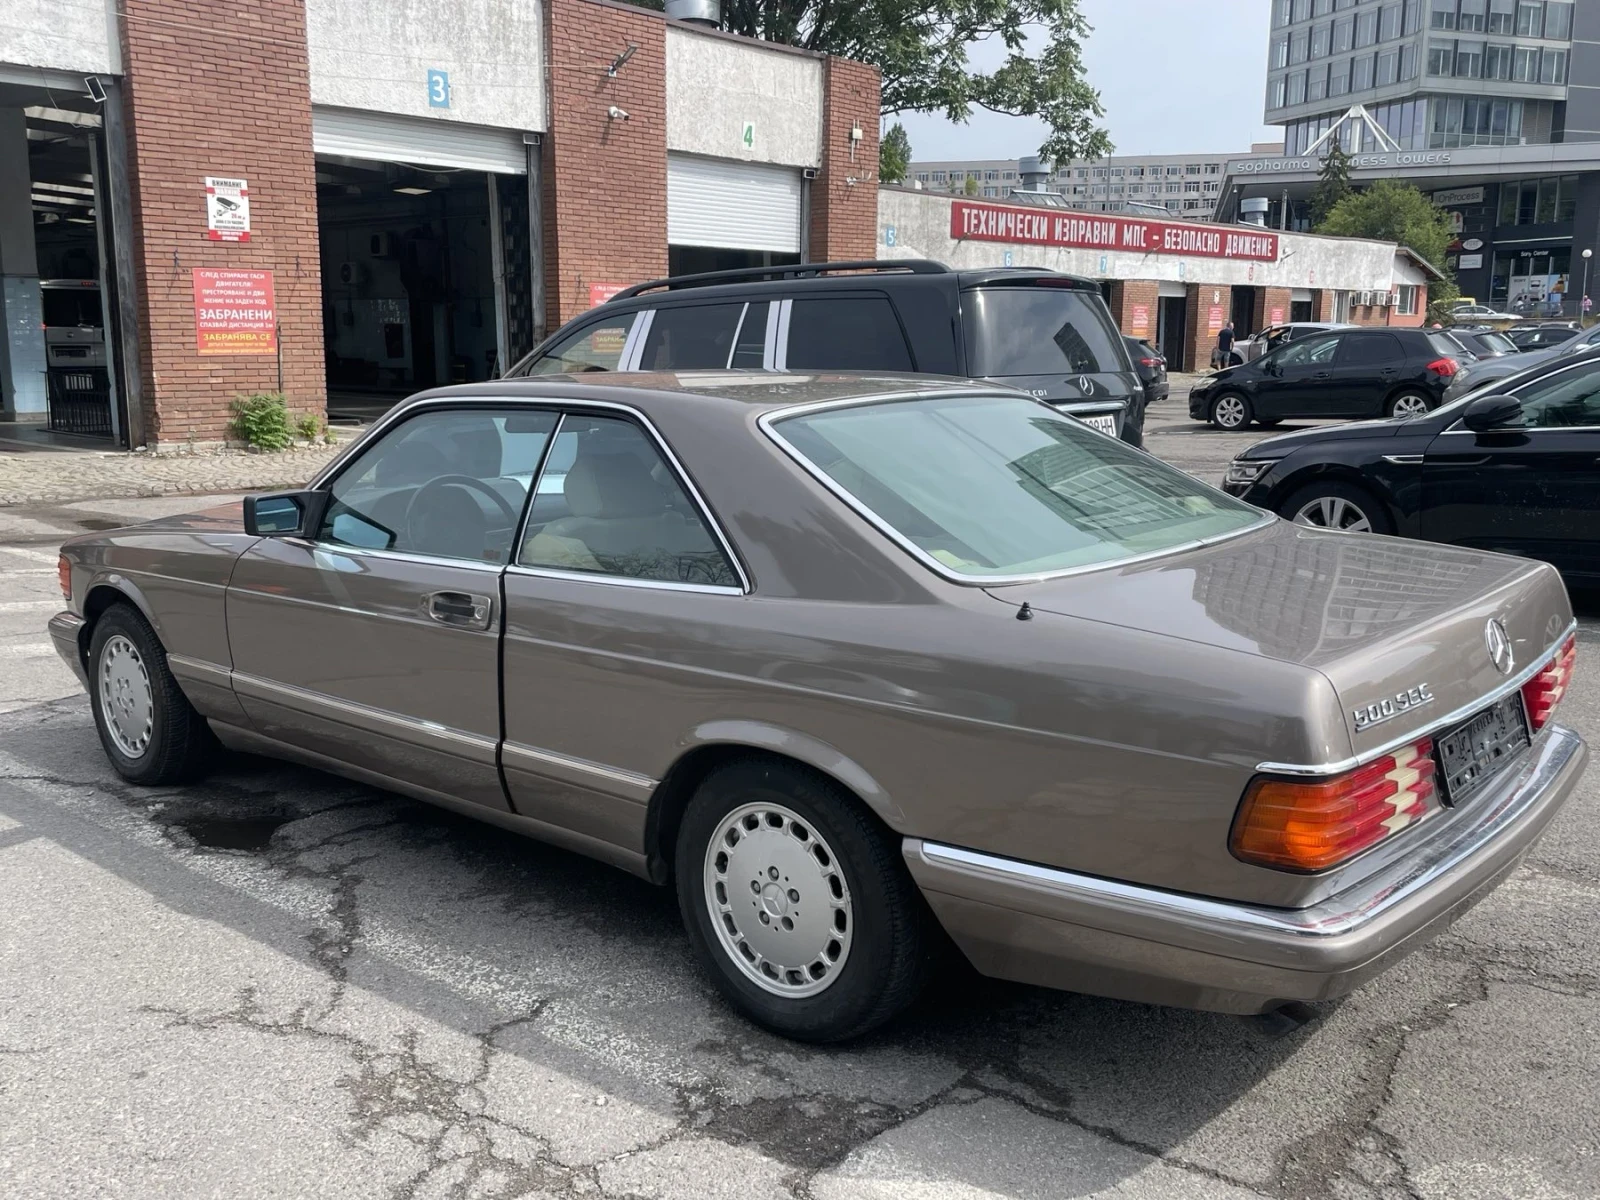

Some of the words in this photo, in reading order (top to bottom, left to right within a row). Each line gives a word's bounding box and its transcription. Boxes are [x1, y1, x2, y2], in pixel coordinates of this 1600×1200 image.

[432, 75, 446, 103] 3
[743, 125, 753, 147] 4
[1237, 158, 1310, 174] sopharma
[1318, 152, 1388, 171] bness
[1396, 151, 1451, 165] towers
[1439, 192, 1480, 203] OnProcess
[887, 230, 895, 244] 5
[962, 208, 1048, 240] ТЕХНИЧЕСКИ
[1054, 217, 1117, 246] ИЗПРАВНИ
[1123, 224, 1148, 248] МПС
[1164, 228, 1220, 253] БЕЗОПАСНО
[1225, 234, 1273, 257] ДВИЖЕНИЕ
[1005, 253, 1012, 266] 6
[1101, 258, 1107, 273] 7
[200, 308, 273, 320] ЗАБРАНЕНИ
[229, 321, 264, 329] ДИСТАНЦИЯ
[203, 333, 258, 341] ЗАБРАНЯВА
[260, 333, 272, 341] СЕ
[1032, 389, 1048, 397] CDI
[1353, 700, 1395, 727] 500
[1395, 683, 1433, 710] SEC
